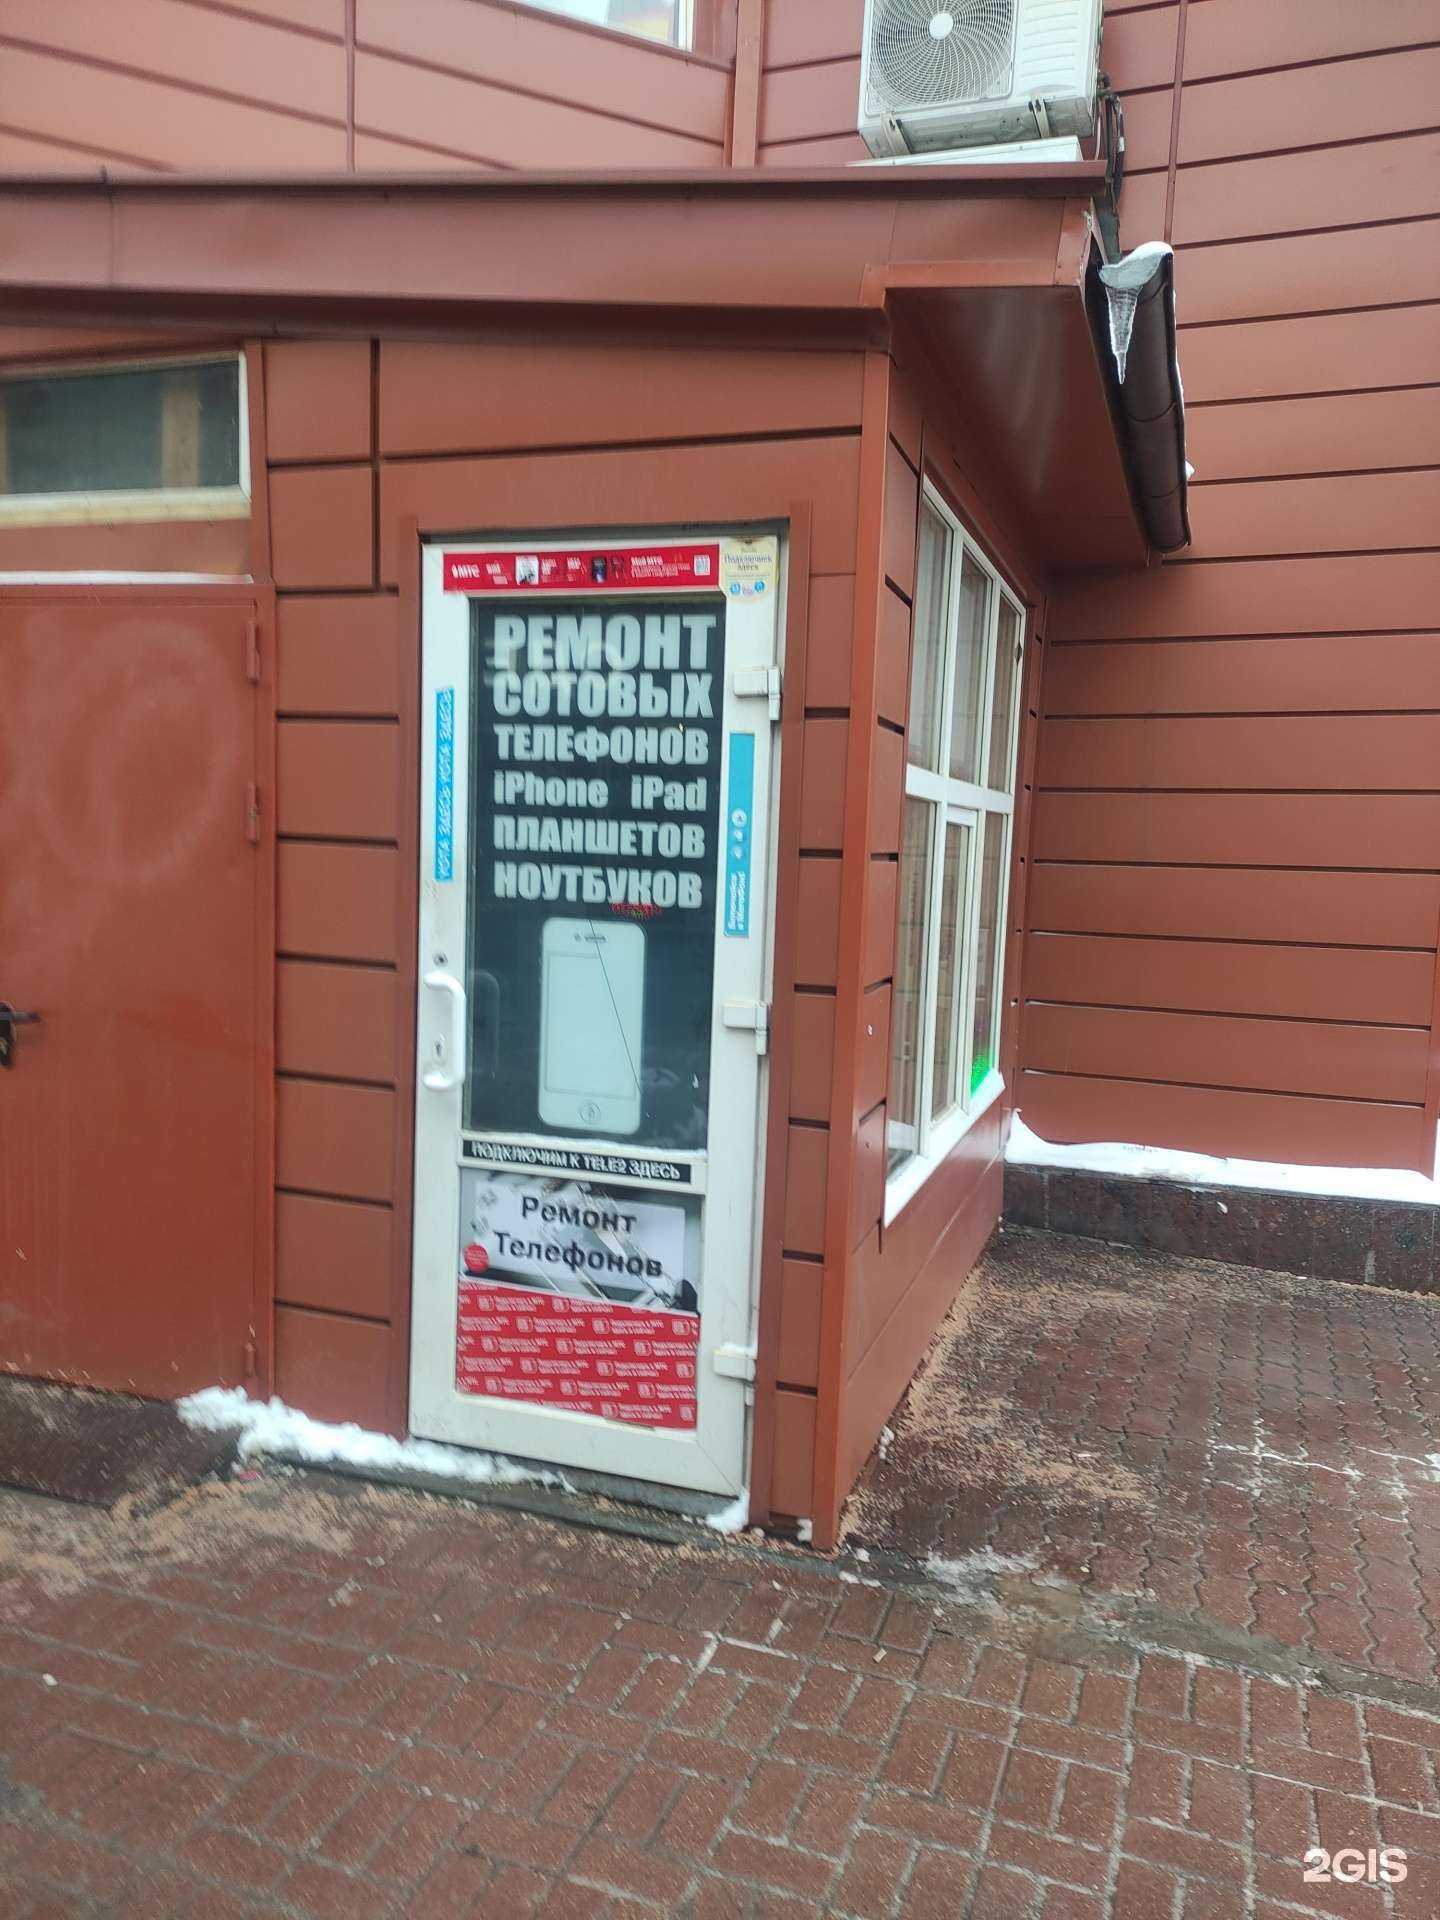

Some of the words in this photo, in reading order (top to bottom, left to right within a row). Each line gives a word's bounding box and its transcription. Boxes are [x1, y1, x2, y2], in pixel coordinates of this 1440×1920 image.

[494, 614, 717, 670] РЕМОНТ
[493, 671, 714, 718] СОТОВЫХ
[494, 723, 709, 765] ТЕЛЕФОНОВ
[494, 769, 609, 808] iPhone
[631, 775, 707, 811] iPad
[493, 814, 705, 859] ПЛАНШЕТОВ
[494, 861, 703, 908] НОУТБУКОВ
[472, 1141, 567, 1167] ПОДКЛЮЧИМ
[569, 1152, 580, 1169] К
[582, 1154, 627, 1174] TELE2
[629, 1160, 680, 1179] ЗДЕСЬ
[521, 1196, 637, 1234] Ремонт
[492, 1229, 663, 1277] Телефонов
